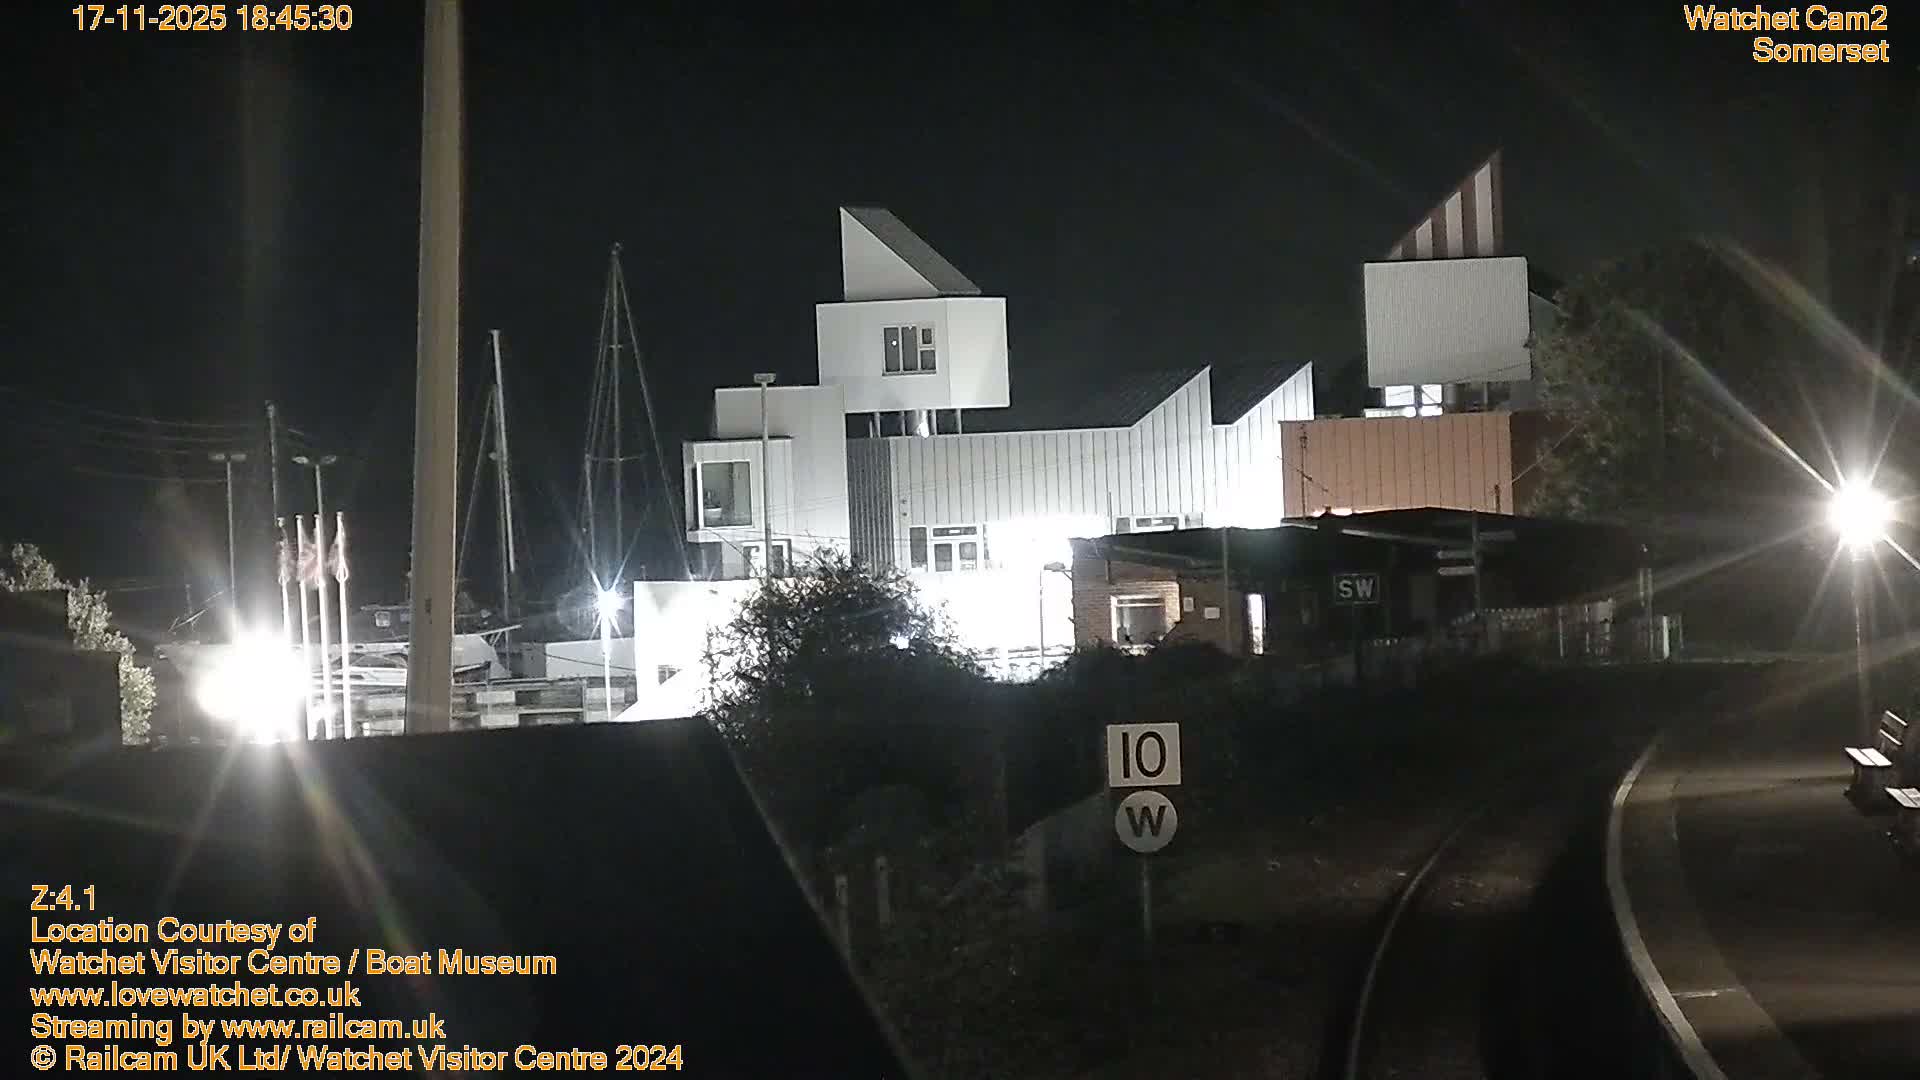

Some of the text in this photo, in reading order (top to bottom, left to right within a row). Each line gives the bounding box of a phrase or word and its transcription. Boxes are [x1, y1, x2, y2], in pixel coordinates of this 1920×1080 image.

[1339, 579, 1374, 599] SW
[1122, 731, 1166, 778] 10
[1125, 805, 1167, 838] W
